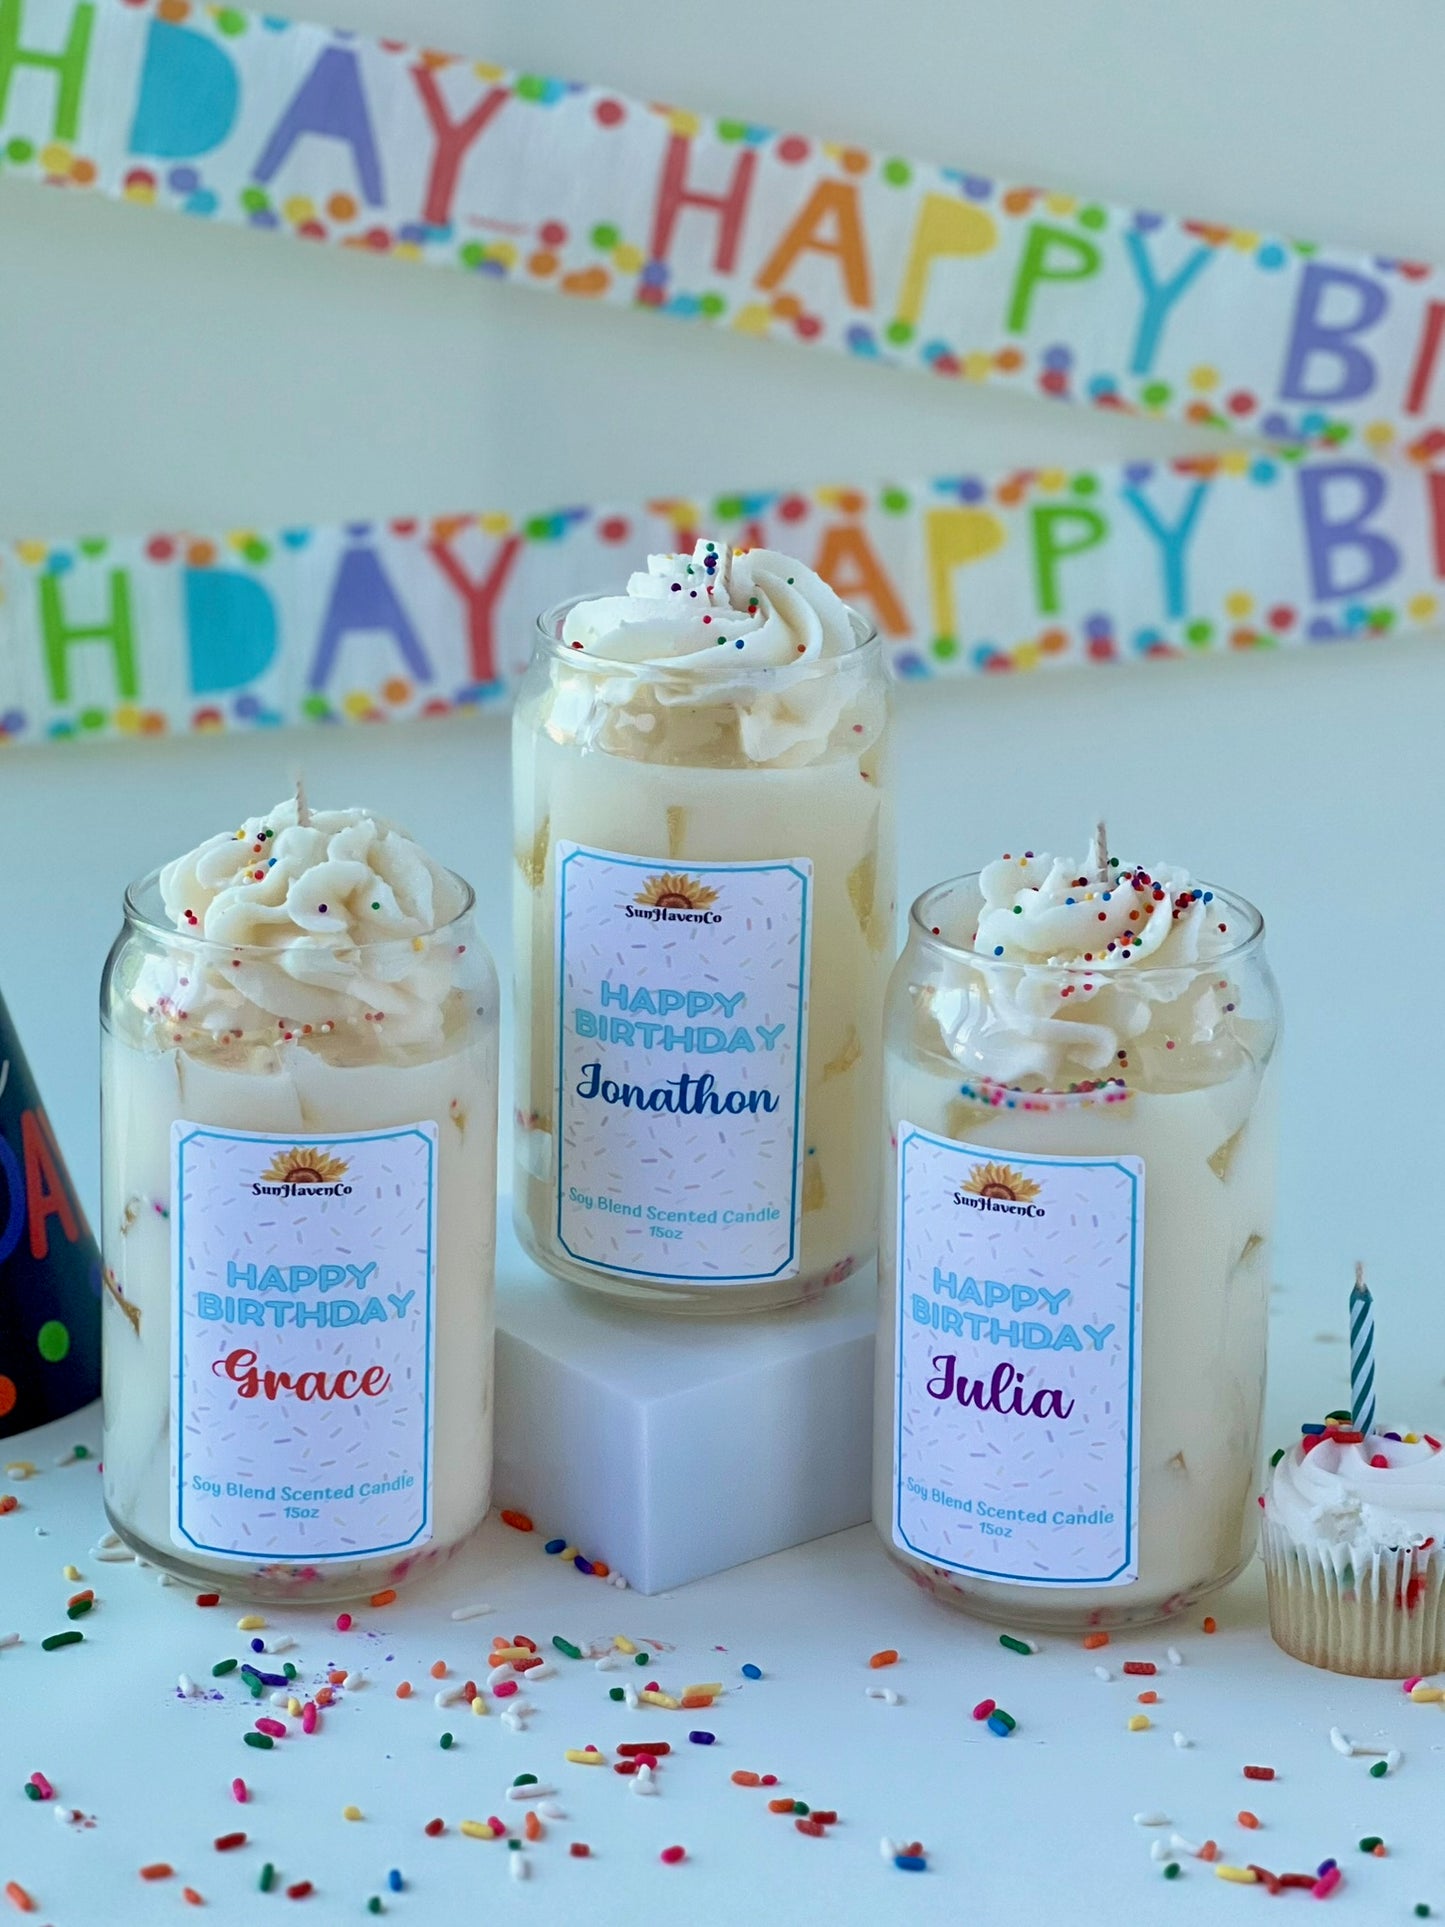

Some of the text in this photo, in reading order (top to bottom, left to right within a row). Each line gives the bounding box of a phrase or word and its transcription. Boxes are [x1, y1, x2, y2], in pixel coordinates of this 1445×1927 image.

[651, 130, 1217, 376] HAPPY
[675, 478, 1209, 638] APPY
[625, 904, 723, 925] SunHavenCo
[600, 980, 746, 1019] HAPPY
[574, 1007, 786, 1054] BIRTHDAY
[575, 1062, 780, 1115] Jonathon
[252, 1182, 353, 1199] SunHavenCo
[568, 1186, 781, 1224] Soy Blend Scented Candle
[953, 1191, 1046, 1219] SunHavenCo
[648, 1225, 684, 1240] 15oz
[227, 1261, 378, 1293] HAPPY
[932, 1266, 1072, 1315] HAPPY
[197, 1289, 416, 1329] BIRTHDAY
[911, 1293, 1115, 1352] BIRTHDAY
[212, 1348, 391, 1401] Grace
[926, 1354, 1075, 1420] Julia
[192, 1471, 415, 1501] Soy Blend Scented Candle
[906, 1476, 1115, 1526] Soy Blend Scented Candle
[283, 1506, 320, 1519] 15oz
[979, 1521, 1013, 1539] 15oz
